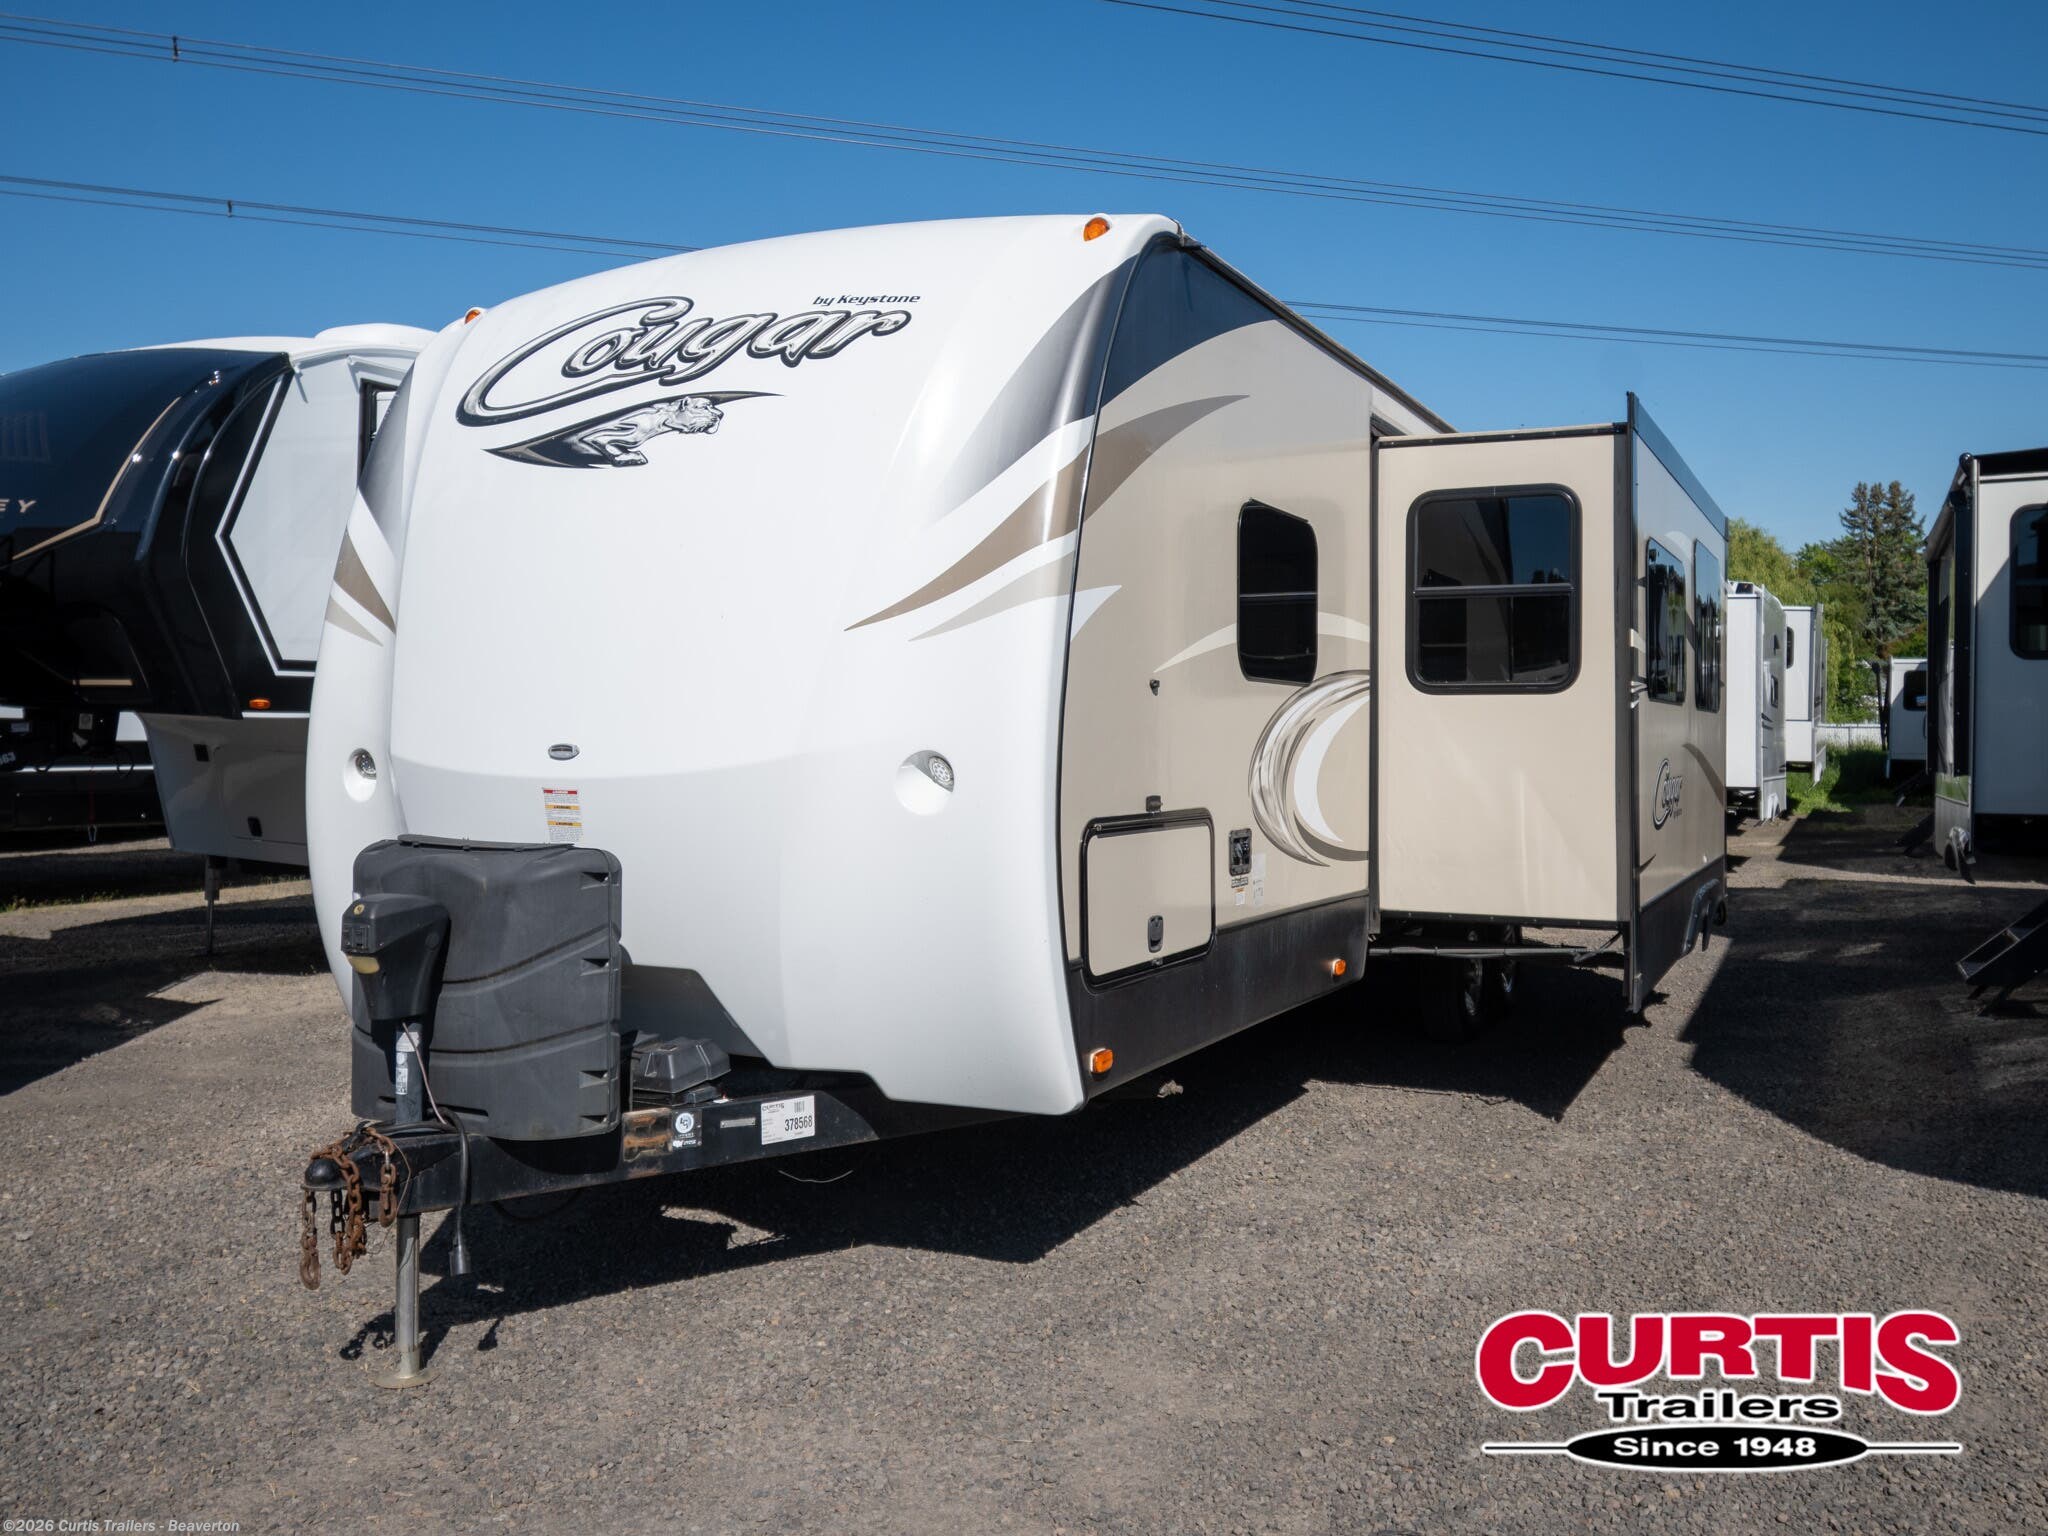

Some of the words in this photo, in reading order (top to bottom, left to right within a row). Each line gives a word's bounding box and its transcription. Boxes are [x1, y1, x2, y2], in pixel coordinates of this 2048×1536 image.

[812, 295, 836, 307] by
[837, 294, 921, 306] Keystone
[455, 296, 912, 428] Cougar
[784, 1115, 813, 1132] 378568
